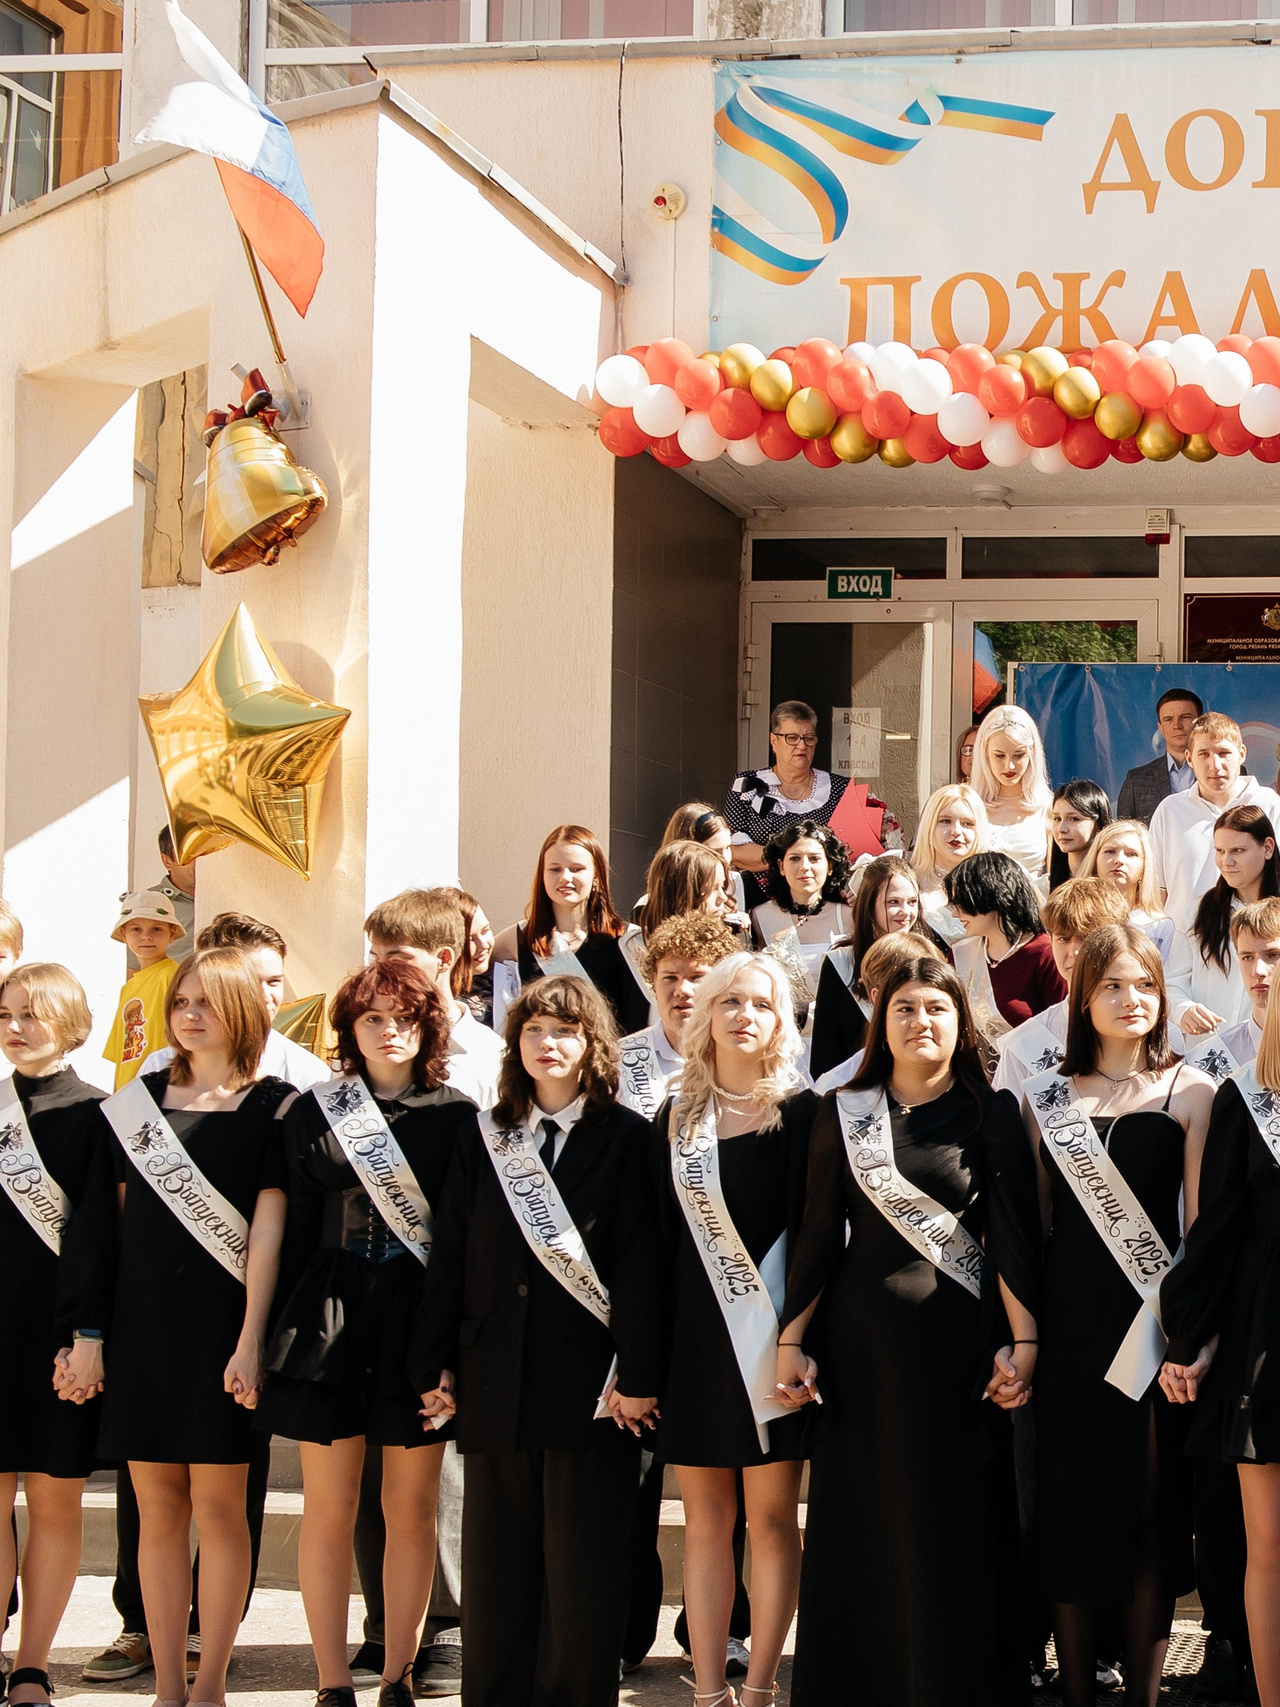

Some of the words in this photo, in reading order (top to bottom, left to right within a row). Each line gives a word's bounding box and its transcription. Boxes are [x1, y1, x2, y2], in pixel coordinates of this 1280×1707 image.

[837, 575, 883, 596] ВХОД
[843, 712, 871, 725] ВХОД
[339, 1118, 424, 1242] Выпускник
[679, 1121, 727, 1253] Выпускник
[718, 1253, 760, 1297] 2025
[854, 1149, 956, 1263] Выпускник
[1044, 1108, 1129, 1238] Выпускник
[1123, 1230, 1170, 1277] 2025
